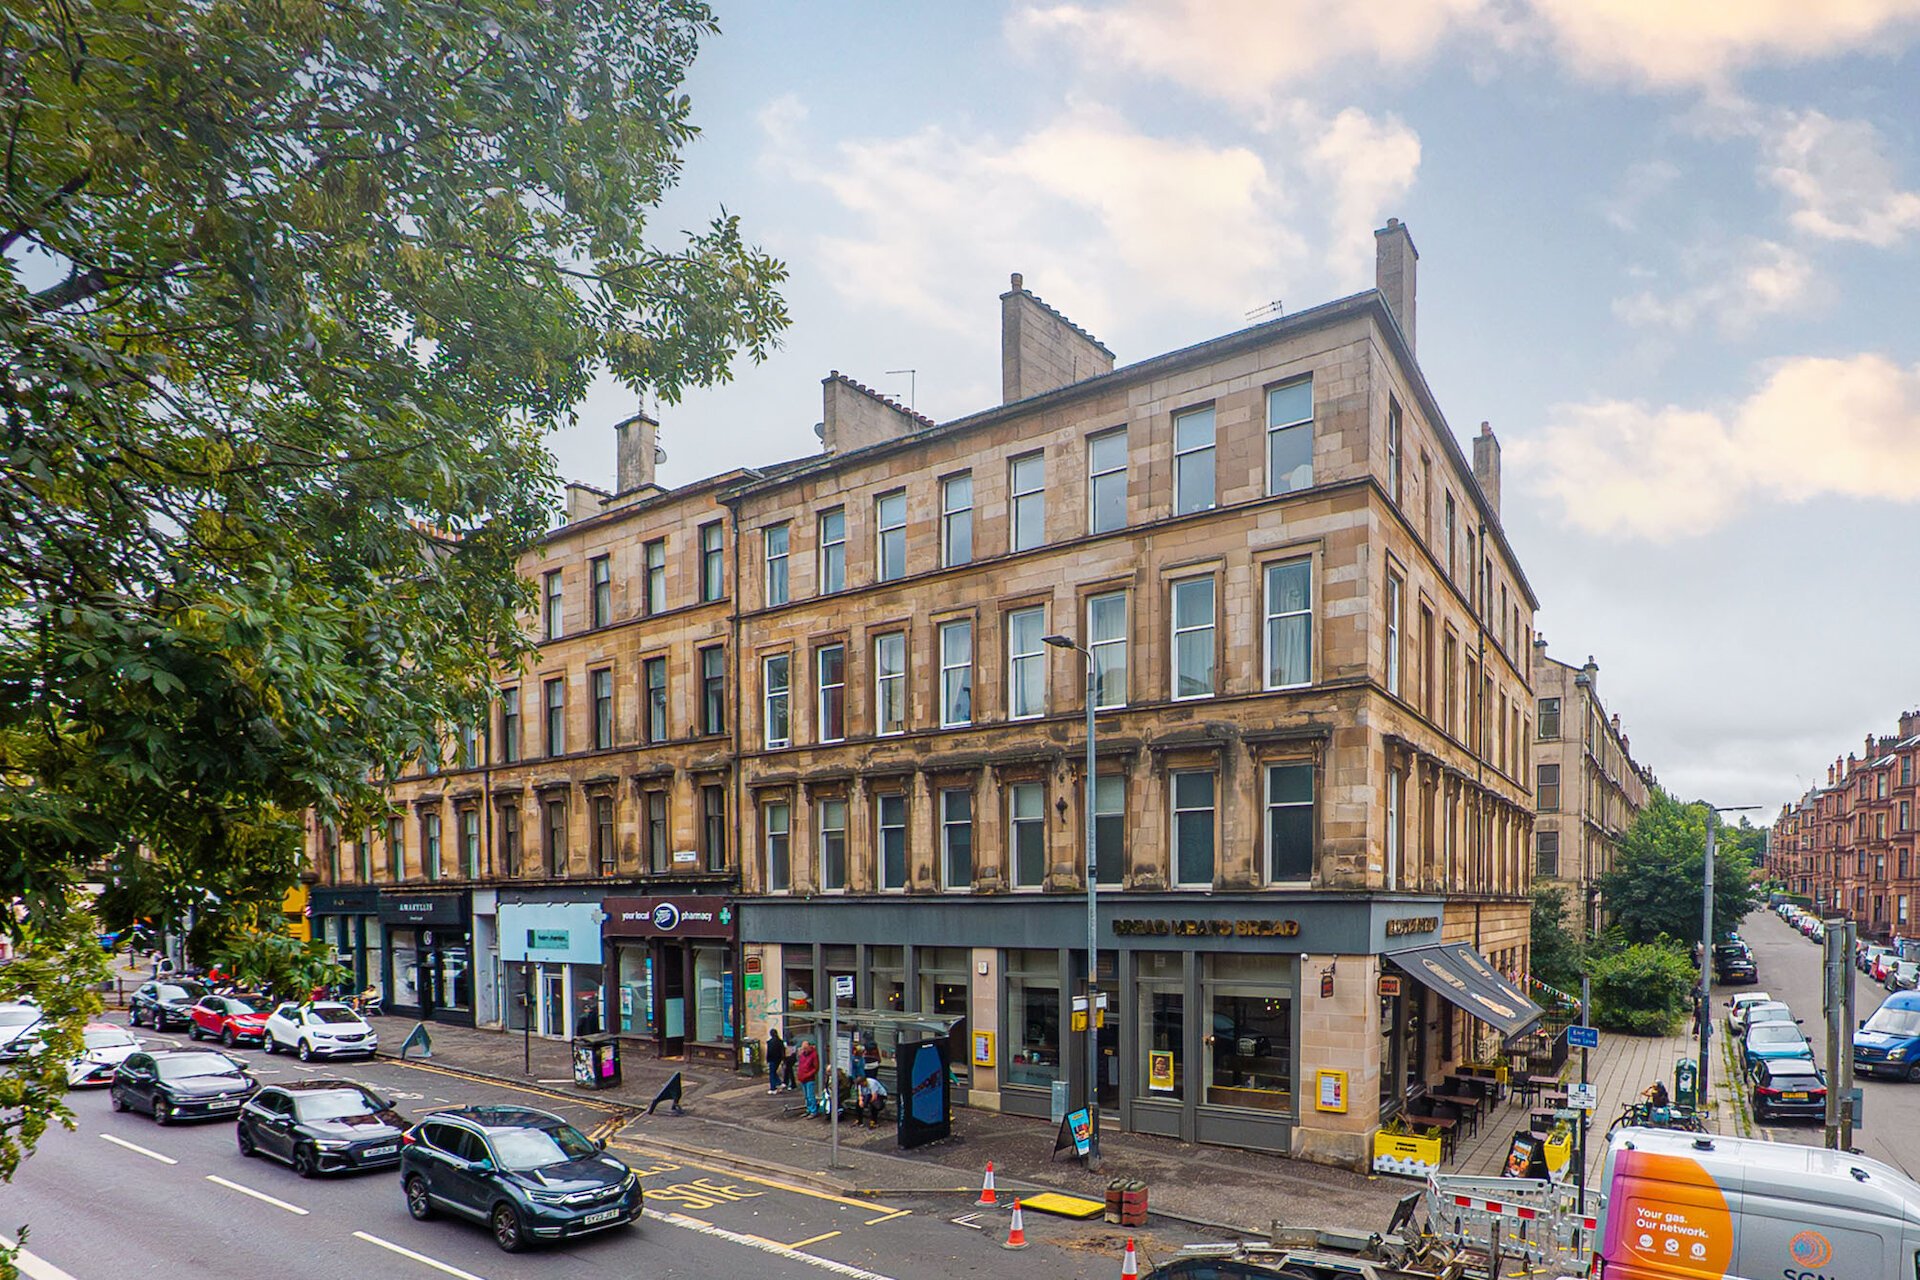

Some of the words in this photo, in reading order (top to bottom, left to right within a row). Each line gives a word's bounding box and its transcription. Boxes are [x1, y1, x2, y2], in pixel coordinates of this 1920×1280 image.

[622, 912, 635, 921] your
[635, 911, 650, 919] local
[681, 911, 713, 921] pharmacy
[1112, 919, 1168, 936] BREAD
[1171, 919, 1233, 937] MEATS
[1234, 919, 1300, 937] BREAD
[1637, 1207, 1663, 1219] Your
[1665, 1212, 1688, 1224] gas.
[1636, 1218, 1657, 1229] Our
[1659, 1223, 1709, 1238] network.
